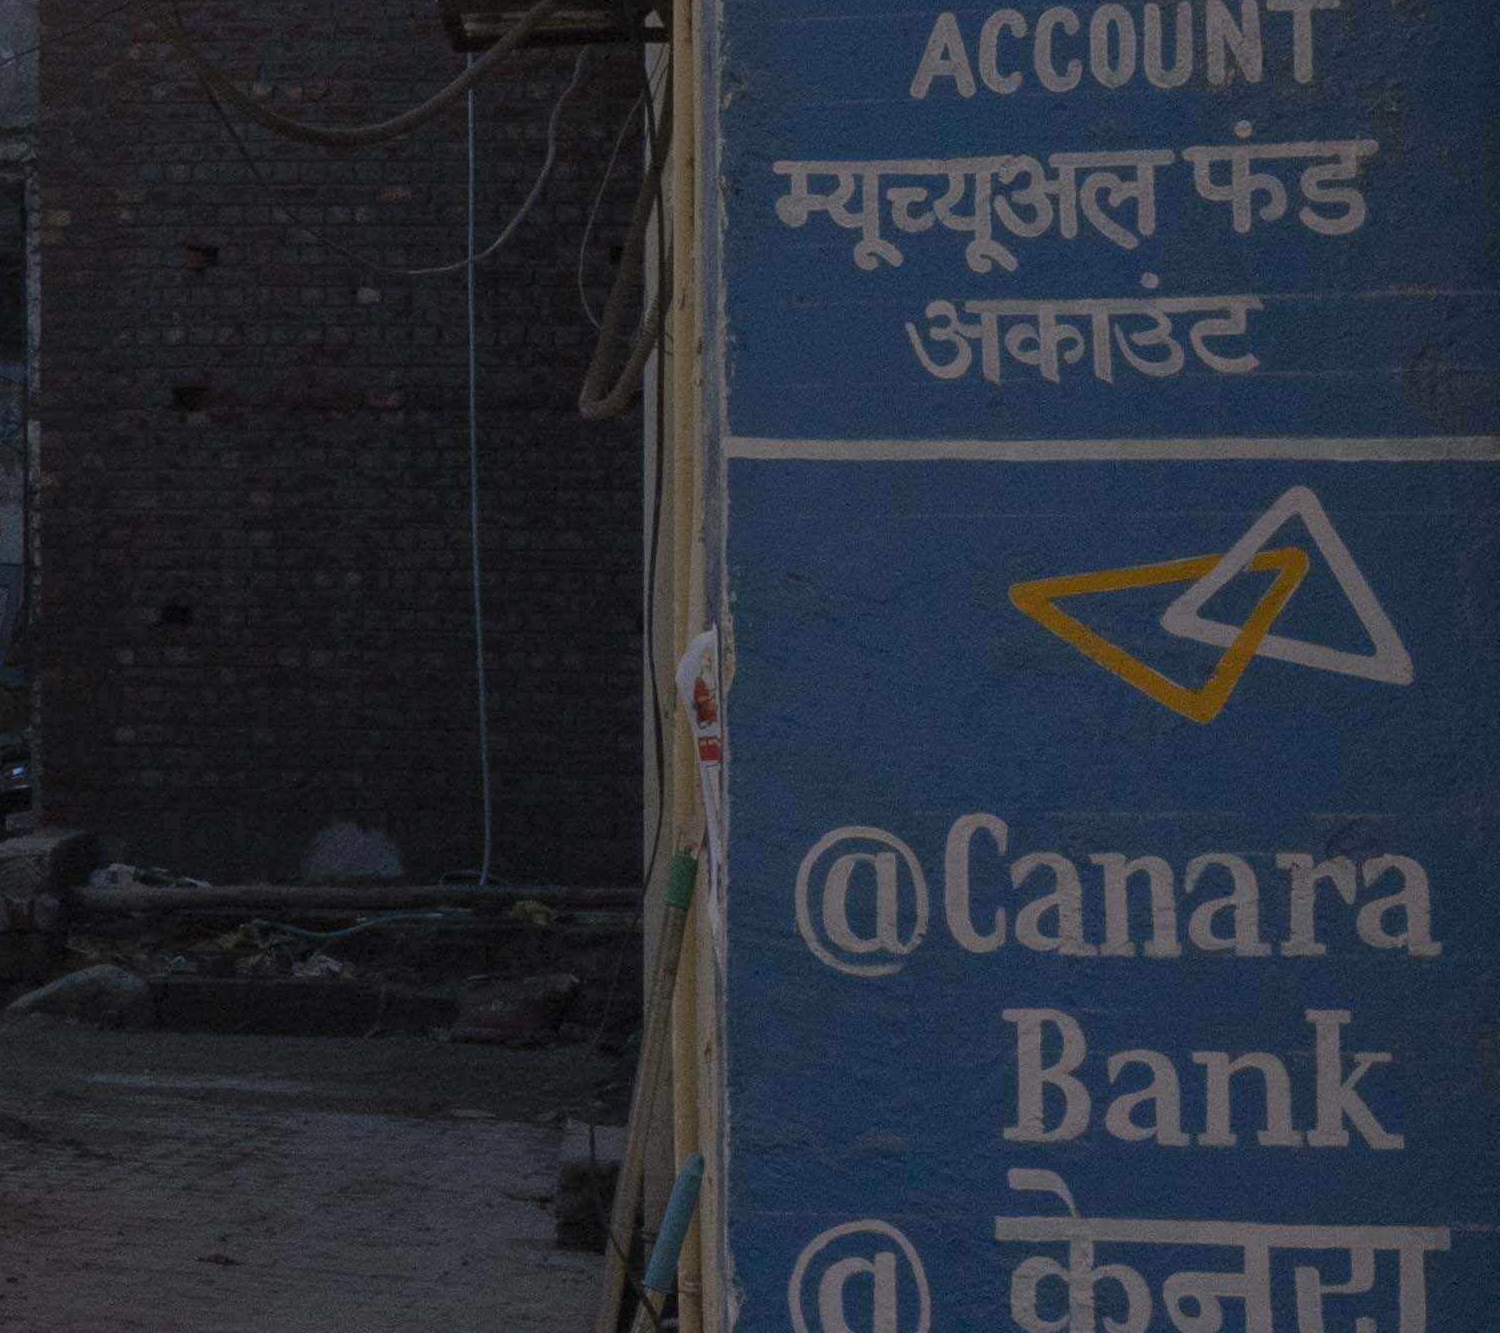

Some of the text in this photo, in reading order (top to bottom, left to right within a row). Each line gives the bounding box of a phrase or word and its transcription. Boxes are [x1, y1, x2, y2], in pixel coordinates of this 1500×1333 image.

[772, 119, 1379, 274] म्यूच्यूअल फंड
[908, 271, 1264, 386] अकाउंट
[1001, 1006, 1405, 1150] Bank
